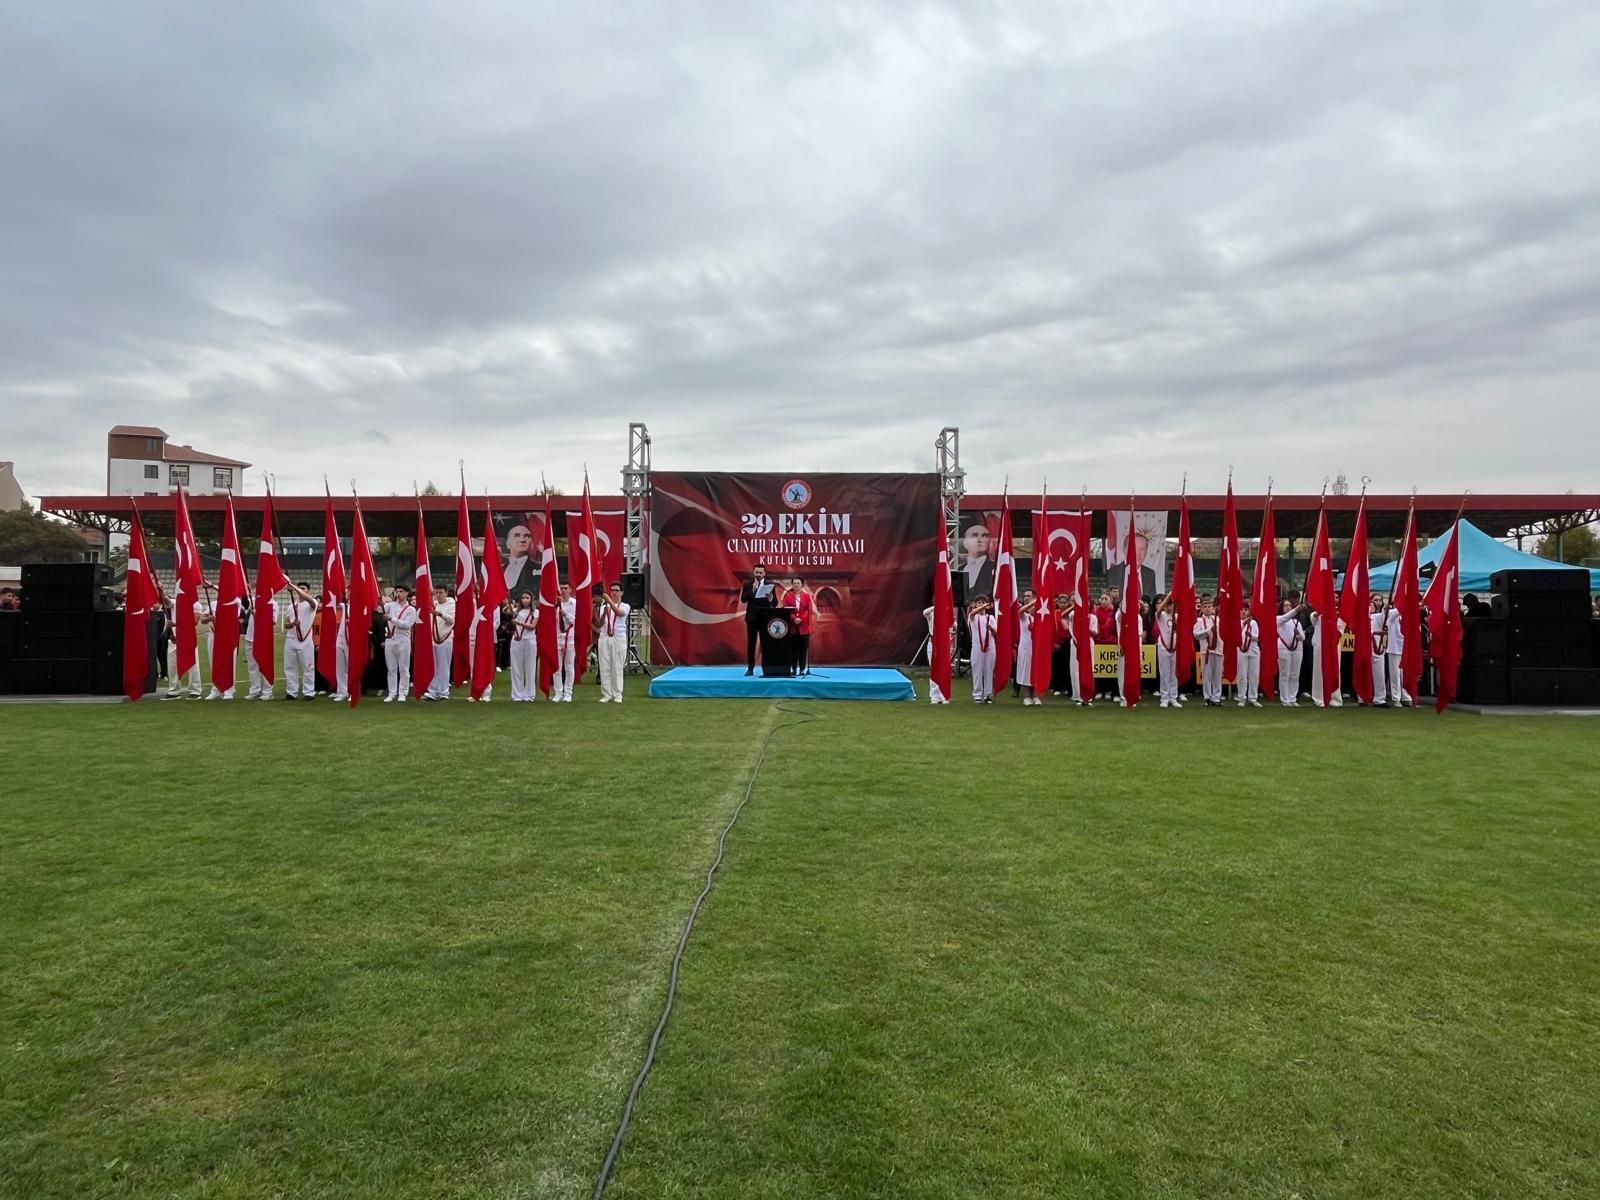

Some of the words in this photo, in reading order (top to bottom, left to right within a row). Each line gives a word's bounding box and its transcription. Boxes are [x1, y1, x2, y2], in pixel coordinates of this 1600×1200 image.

[741, 513, 773, 535] 29
[778, 507, 852, 535] EKİM
[727, 537, 804, 553] CUMHURİYET
[807, 539, 865, 553] BAYRAMI
[760, 555, 793, 566] KUTLU
[799, 555, 833, 566] OLSUN
